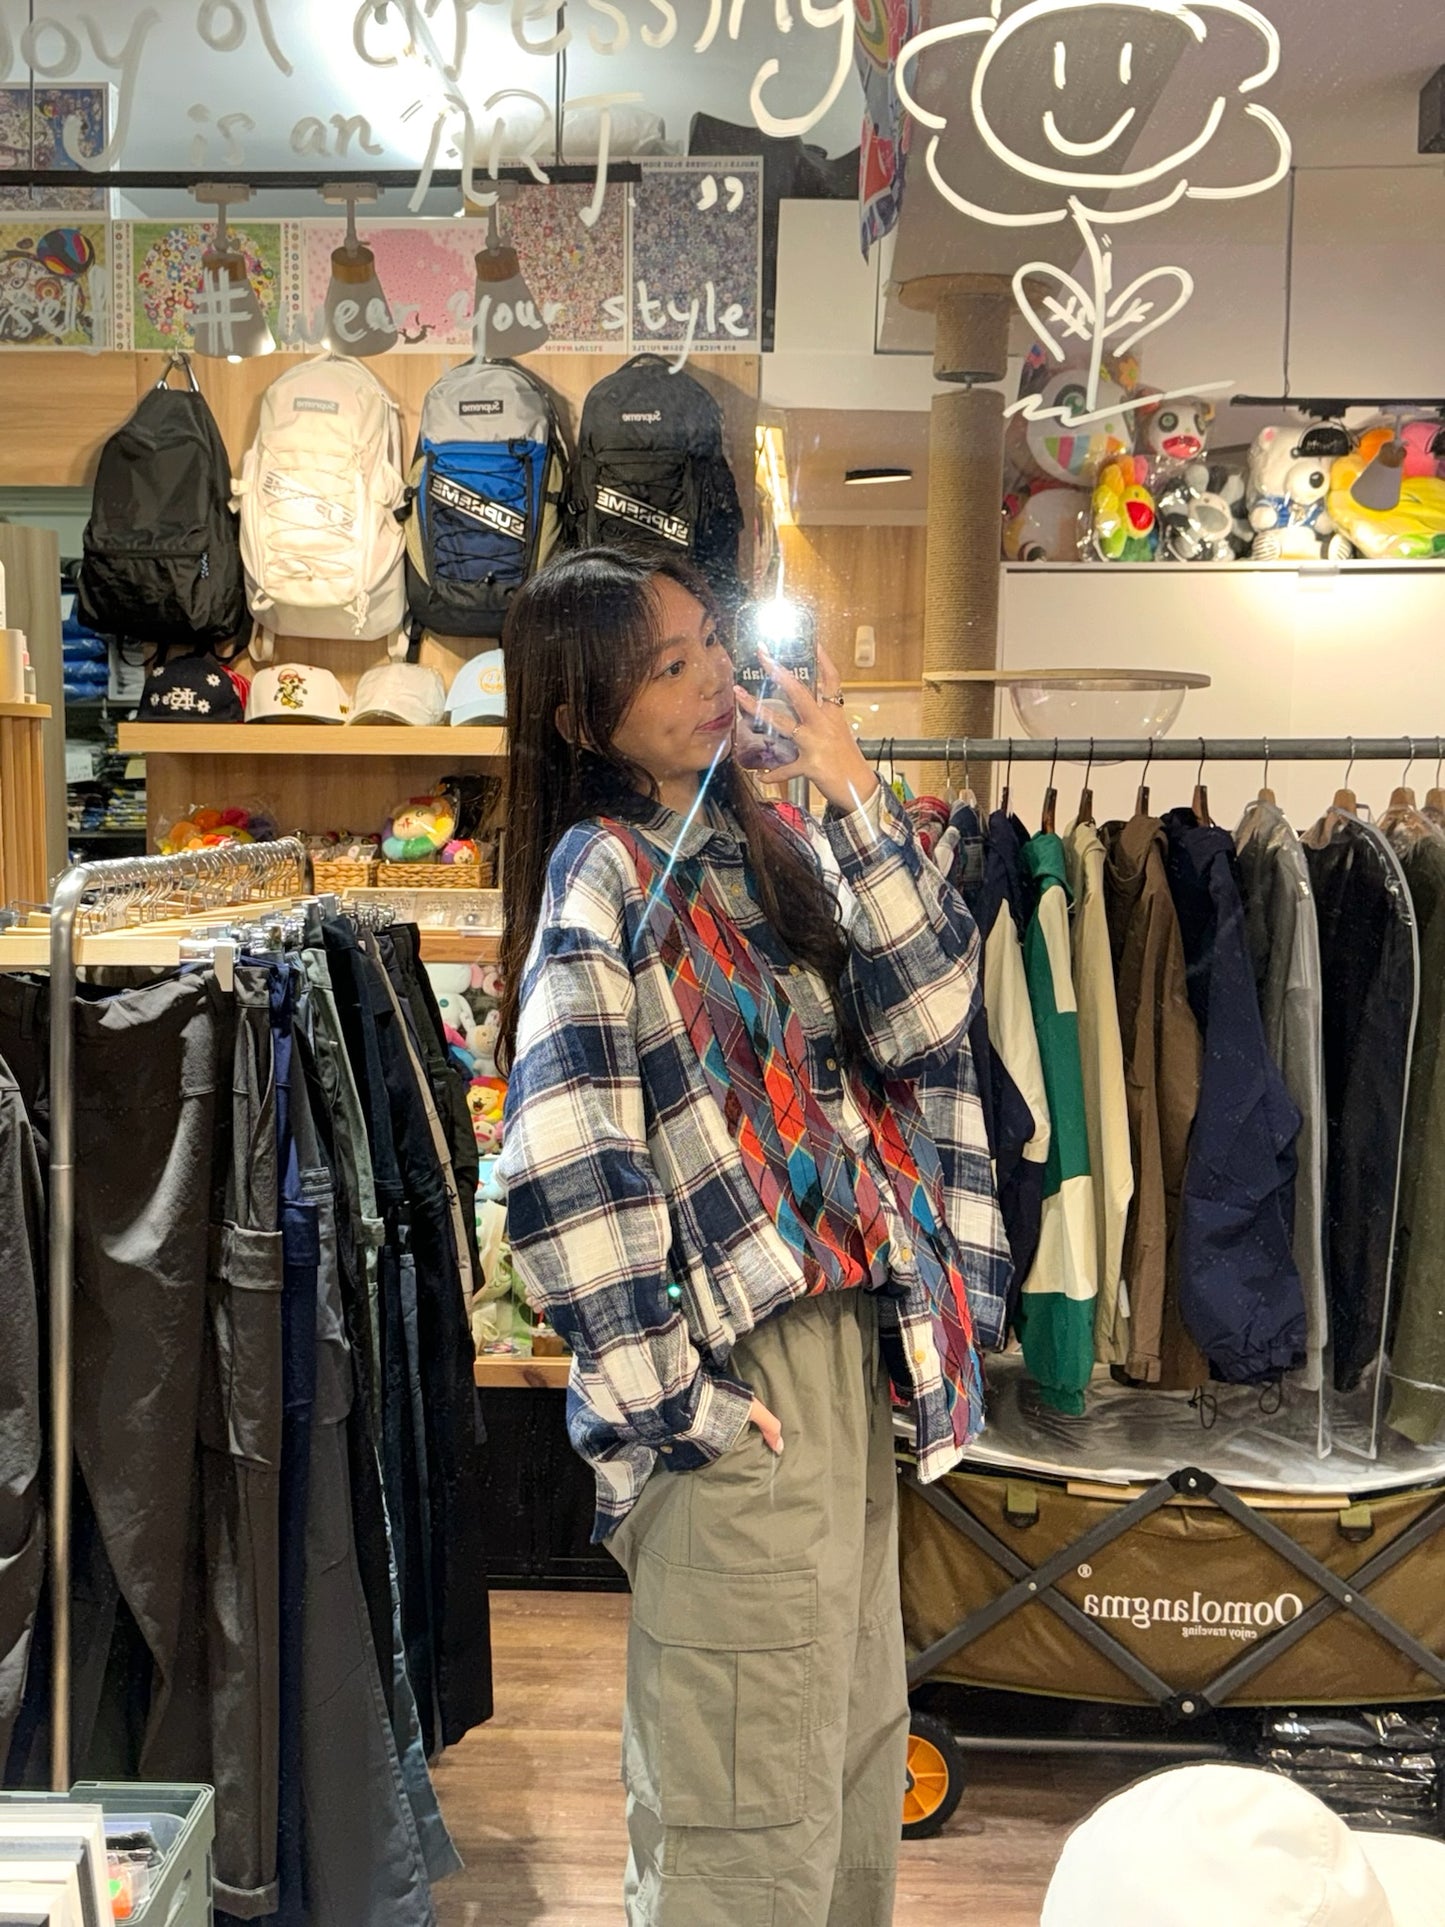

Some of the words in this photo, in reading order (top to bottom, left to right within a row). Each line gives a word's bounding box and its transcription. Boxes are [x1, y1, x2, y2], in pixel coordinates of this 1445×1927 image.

[0, 6, 161, 172] oy
[187, 103, 256, 167] is
[290, 113, 385, 159] an
[408, 88, 645, 229] ART
[447, 290, 566, 372] your
[603, 280, 749, 374] style
